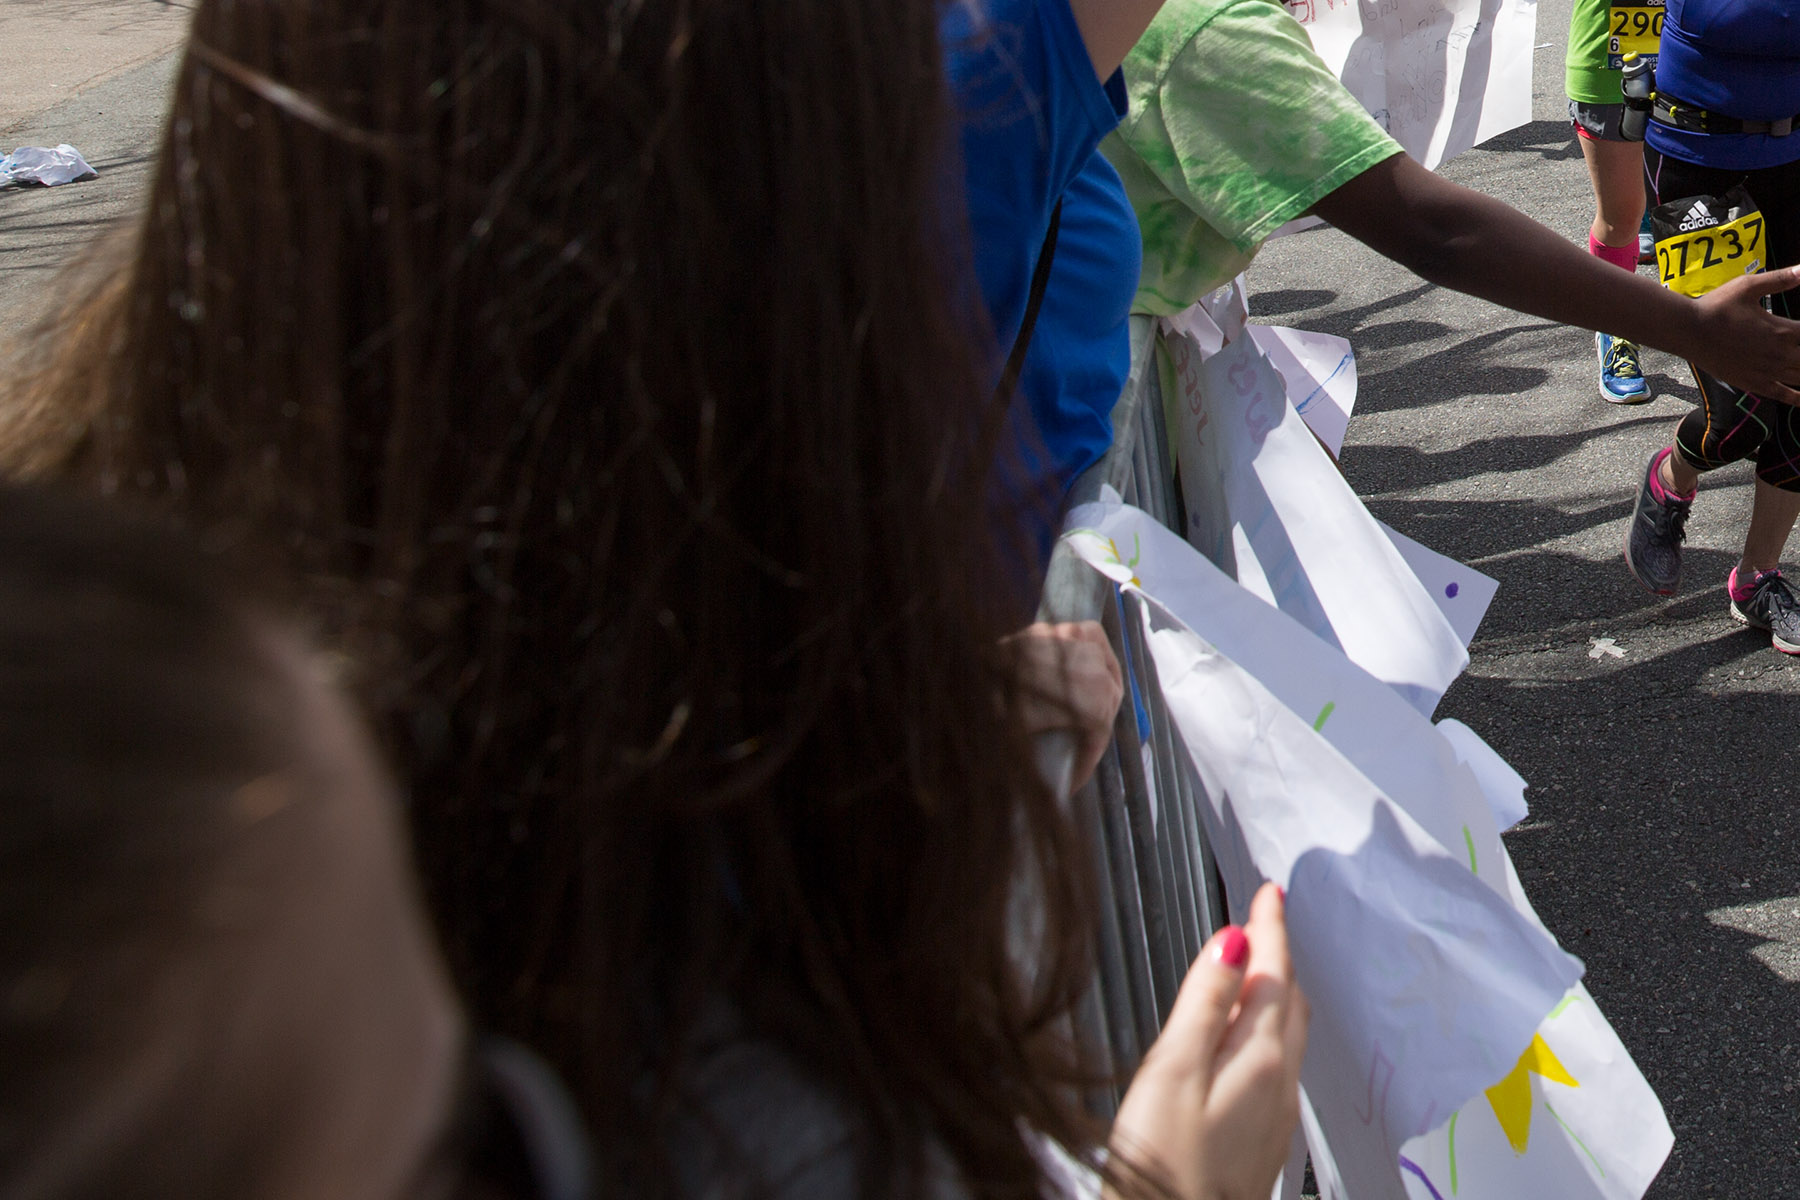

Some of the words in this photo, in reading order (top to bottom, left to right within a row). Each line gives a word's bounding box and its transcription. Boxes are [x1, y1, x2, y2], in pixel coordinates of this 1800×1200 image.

[1612, 11, 1665, 37] 290
[1610, 38, 1619, 52] 6
[1679, 216, 1719, 232] adidas
[1659, 217, 1763, 282] 27237
